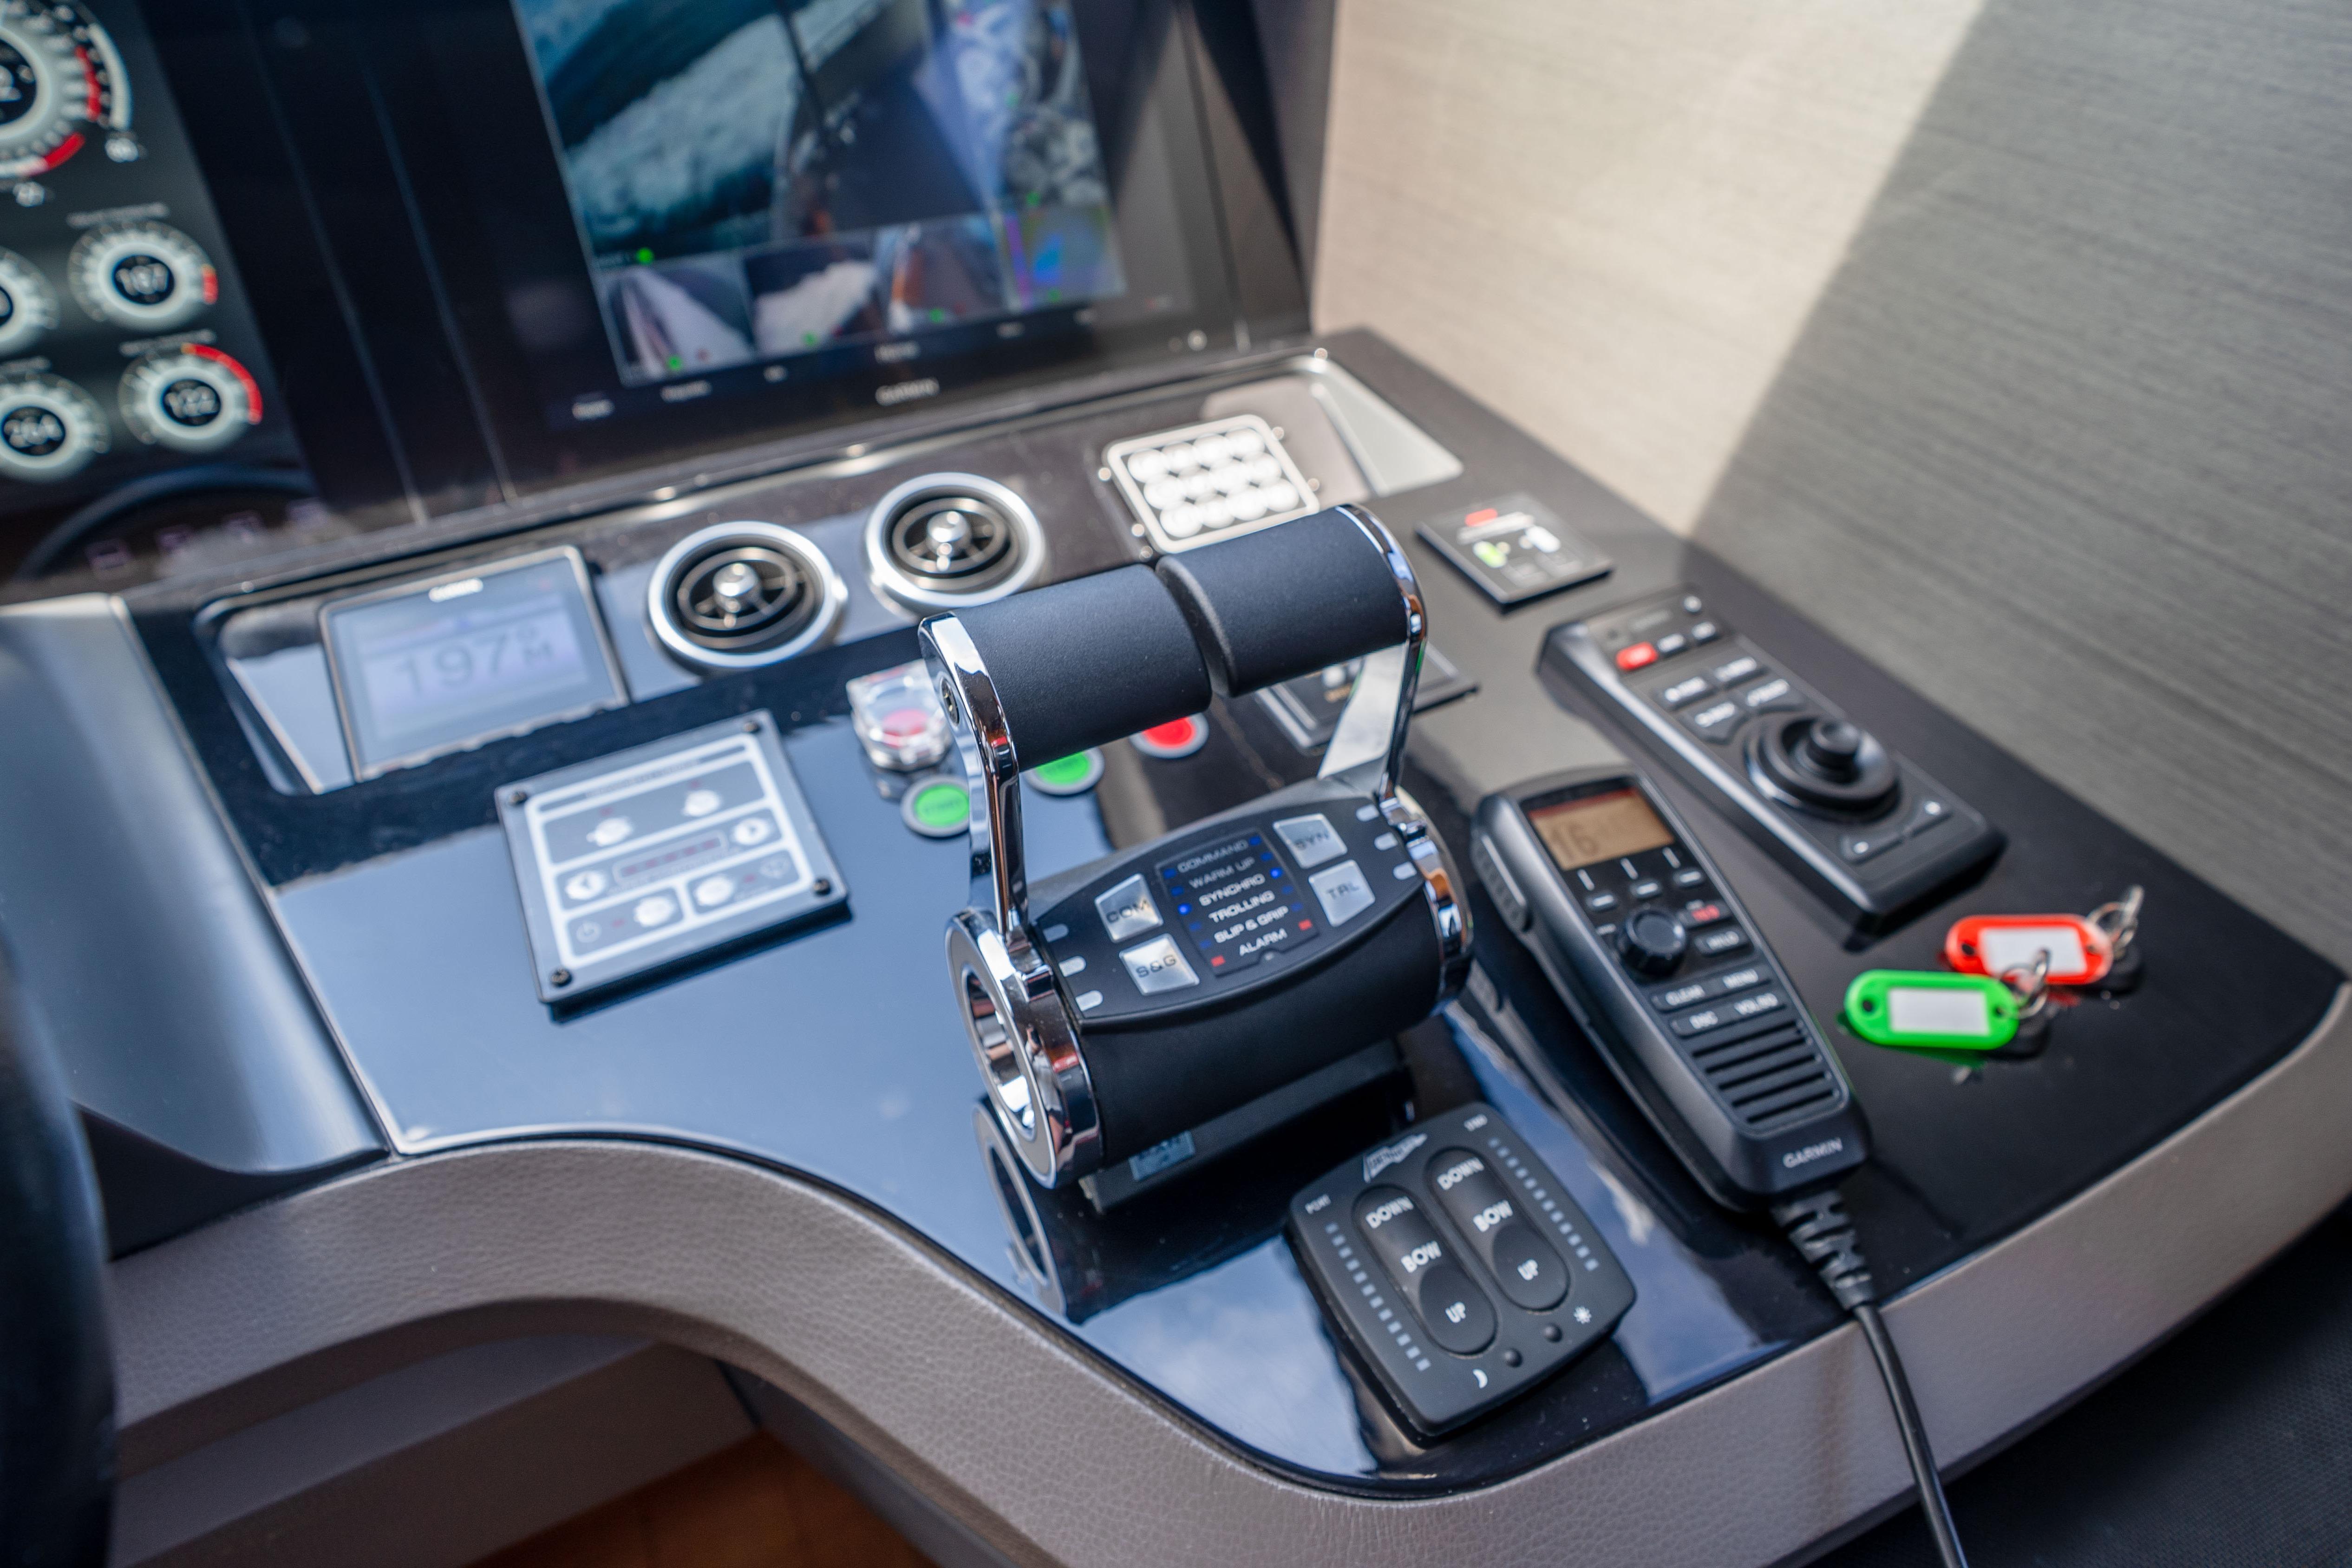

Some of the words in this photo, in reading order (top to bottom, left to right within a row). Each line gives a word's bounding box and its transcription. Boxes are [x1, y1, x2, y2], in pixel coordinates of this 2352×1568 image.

[1293, 829, 1330, 850] SYN
[1177, 839, 1249, 873] COMMAND
[1189, 865, 1235, 889] WARM
[1235, 856, 1255, 871] UP
[1199, 873, 1265, 906] SYNCHRO
[1326, 882, 1359, 900] TRL
[1105, 898, 1150, 924] COM
[1208, 890, 1275, 923] TROLLING
[1214, 923, 1245, 943] SLIP
[1245, 918, 1259, 931] &
[1256, 905, 1289, 926] GRIP
[1239, 928, 1288, 957] ALARM
[1136, 954, 1177, 978] S&G
[1665, 984, 1705, 1005] CLEAR
[1783, 1137, 1843, 1169] GARMIN
[1437, 1156, 1485, 1190] DOWN
[1365, 1196, 1415, 1229] DOWN
[1473, 1199, 1514, 1232] BOW
[1400, 1240, 1442, 1273] BOW
[1517, 1259, 1539, 1281] UP
[1445, 1301, 1467, 1324] UP
